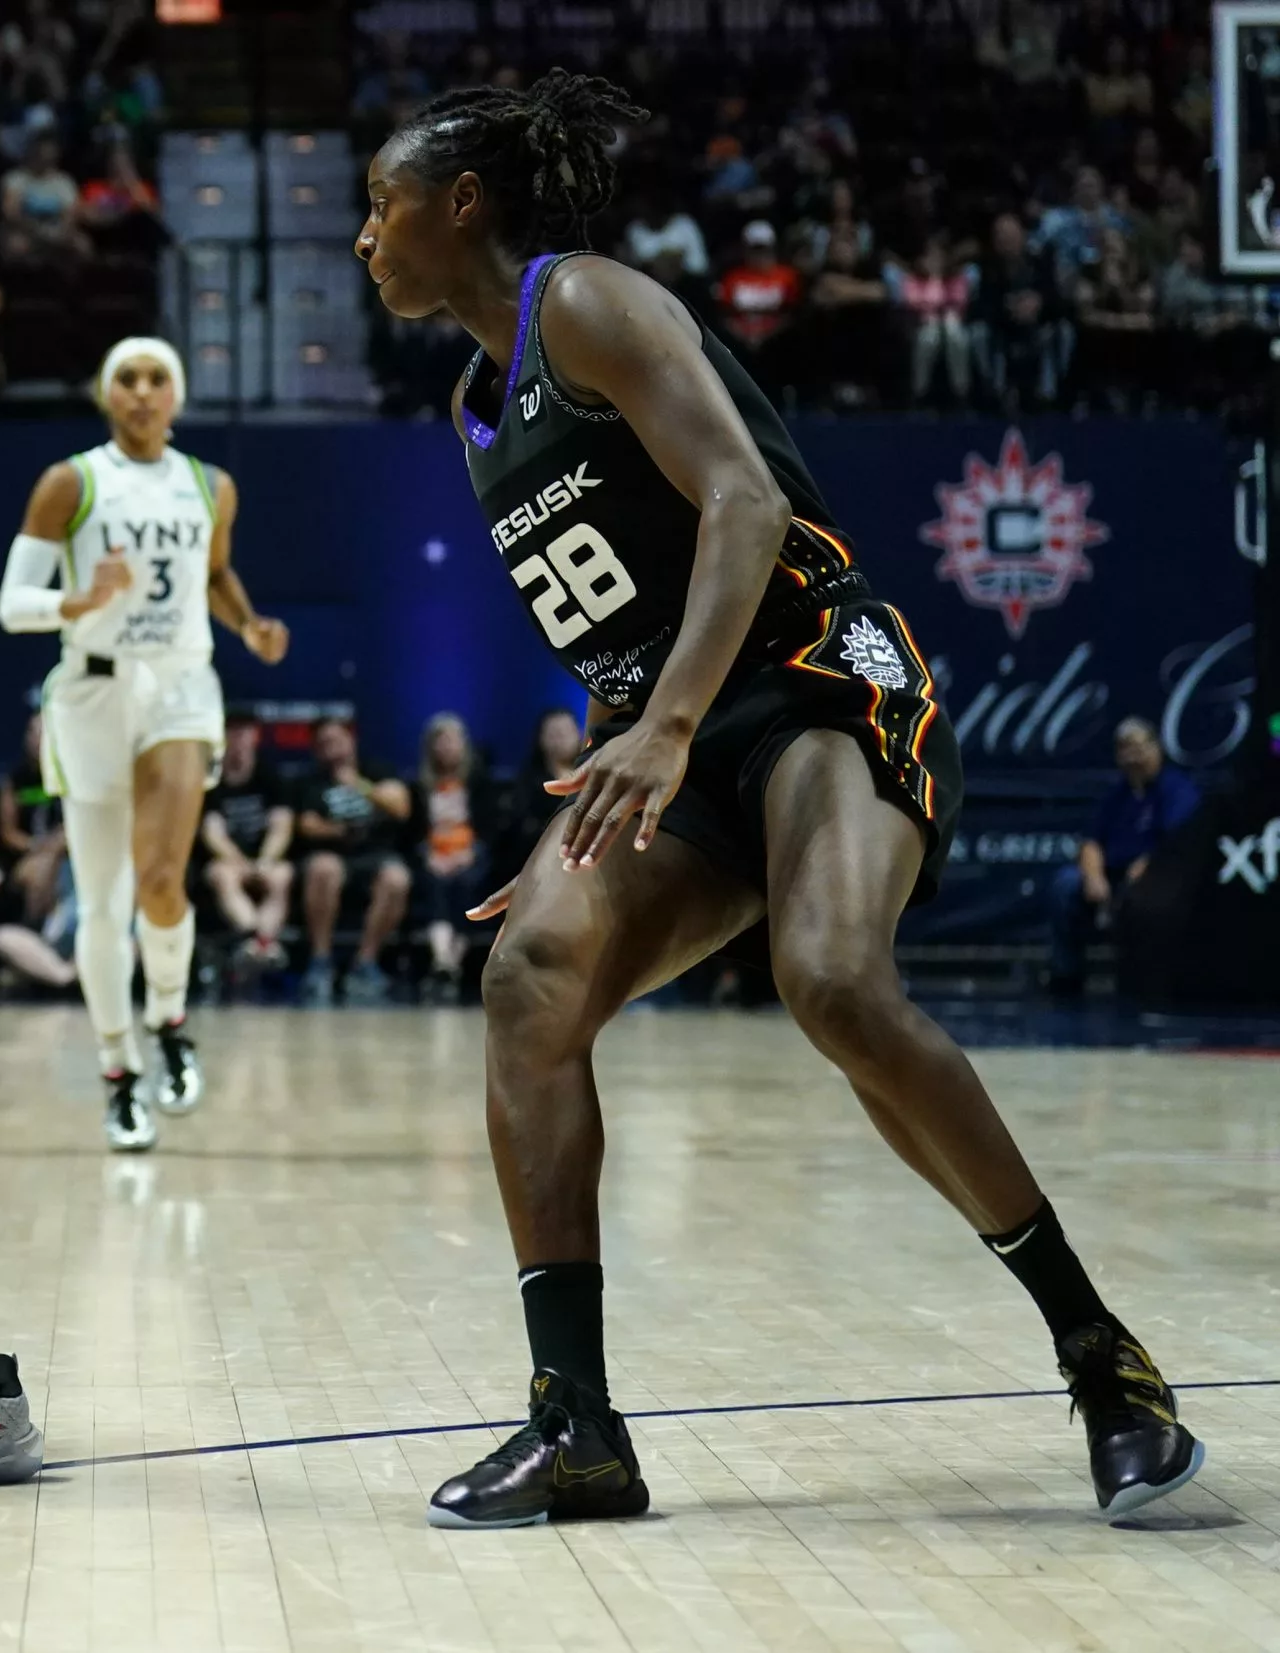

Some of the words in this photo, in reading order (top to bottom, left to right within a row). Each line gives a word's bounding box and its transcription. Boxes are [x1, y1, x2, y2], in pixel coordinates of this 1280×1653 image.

[146, 558, 174, 601] 3
[509, 522, 638, 650] 28
[573, 651, 614, 680] Yale
